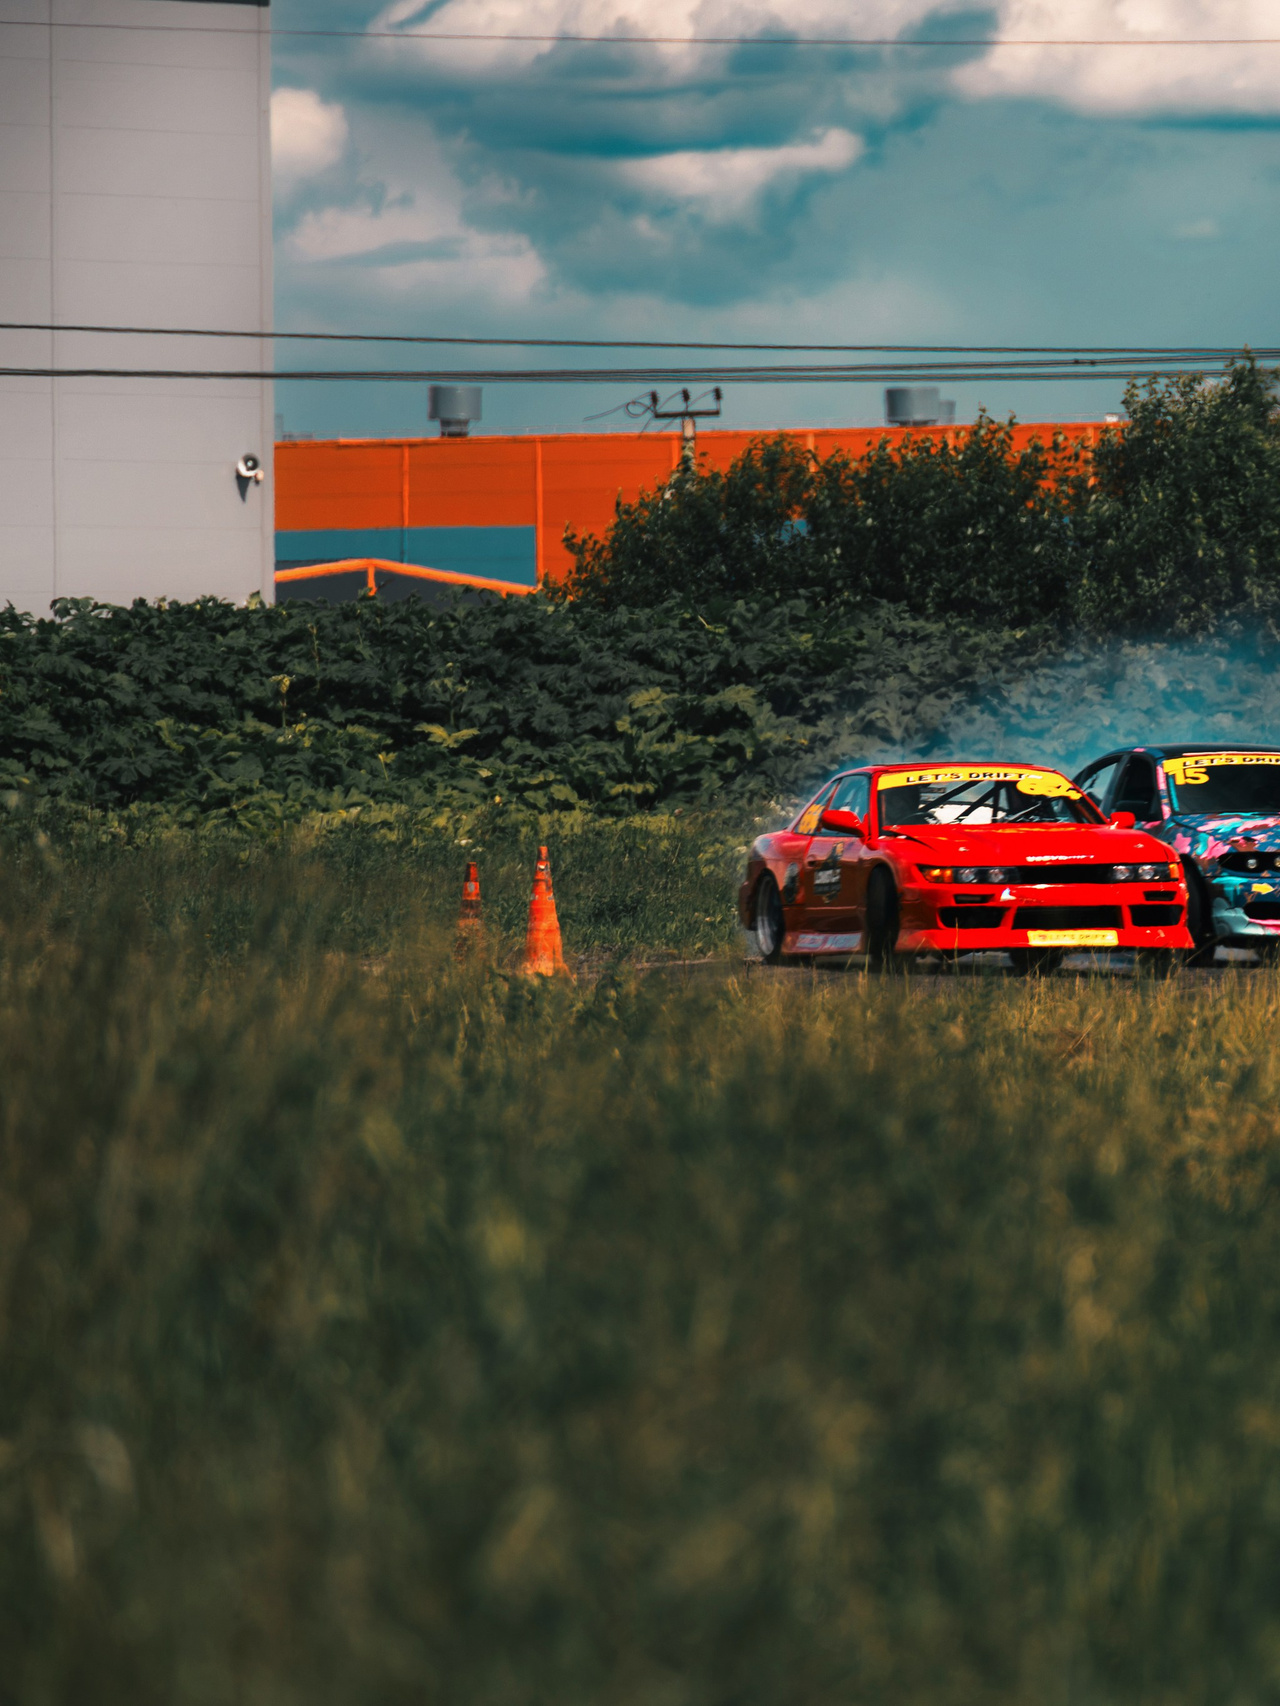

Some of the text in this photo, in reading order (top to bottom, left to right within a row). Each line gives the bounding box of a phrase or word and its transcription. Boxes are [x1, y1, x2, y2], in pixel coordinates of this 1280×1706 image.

[1183, 757, 1234, 767] LET'S
[906, 772, 1027, 783] LET'S DRIFT
[1168, 767, 1210, 785] 15
